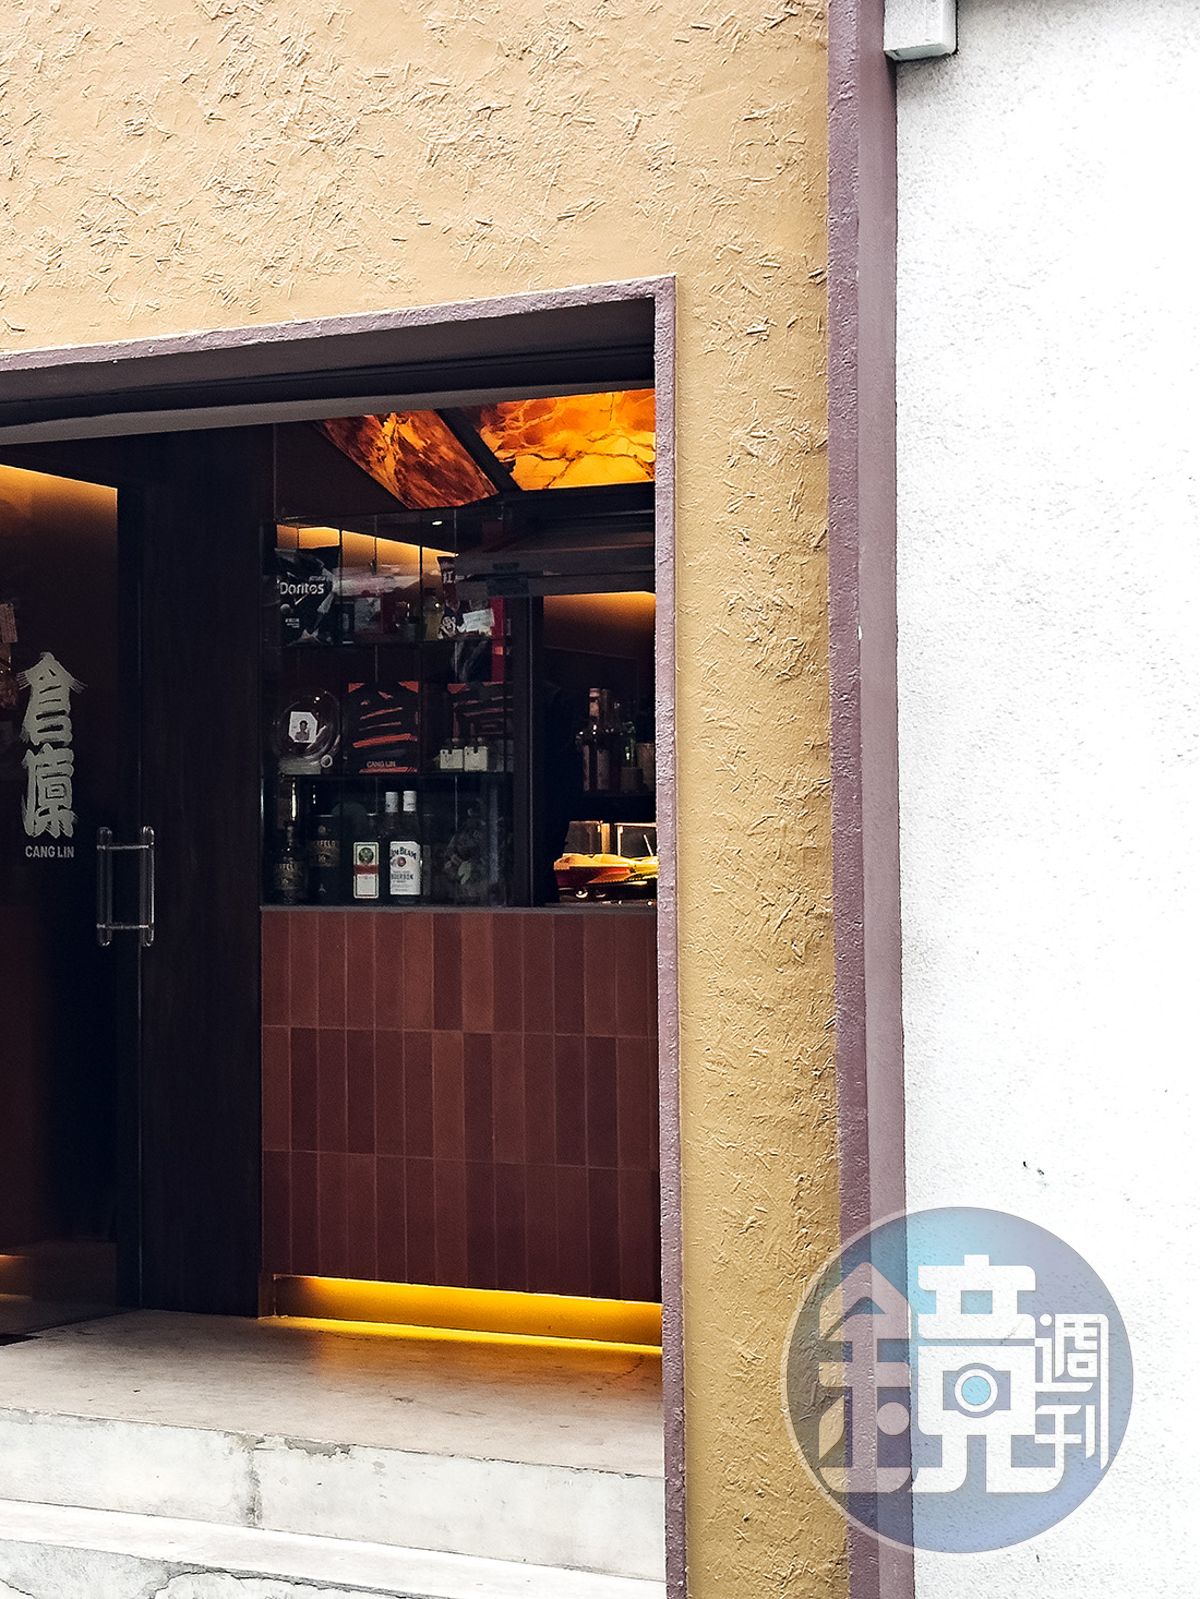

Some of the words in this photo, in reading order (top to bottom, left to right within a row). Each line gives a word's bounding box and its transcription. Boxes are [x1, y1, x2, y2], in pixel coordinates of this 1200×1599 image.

[279, 581, 325, 595] Doritos
[25, 845, 56, 858] CANG
[57, 845, 75, 858] LIN
